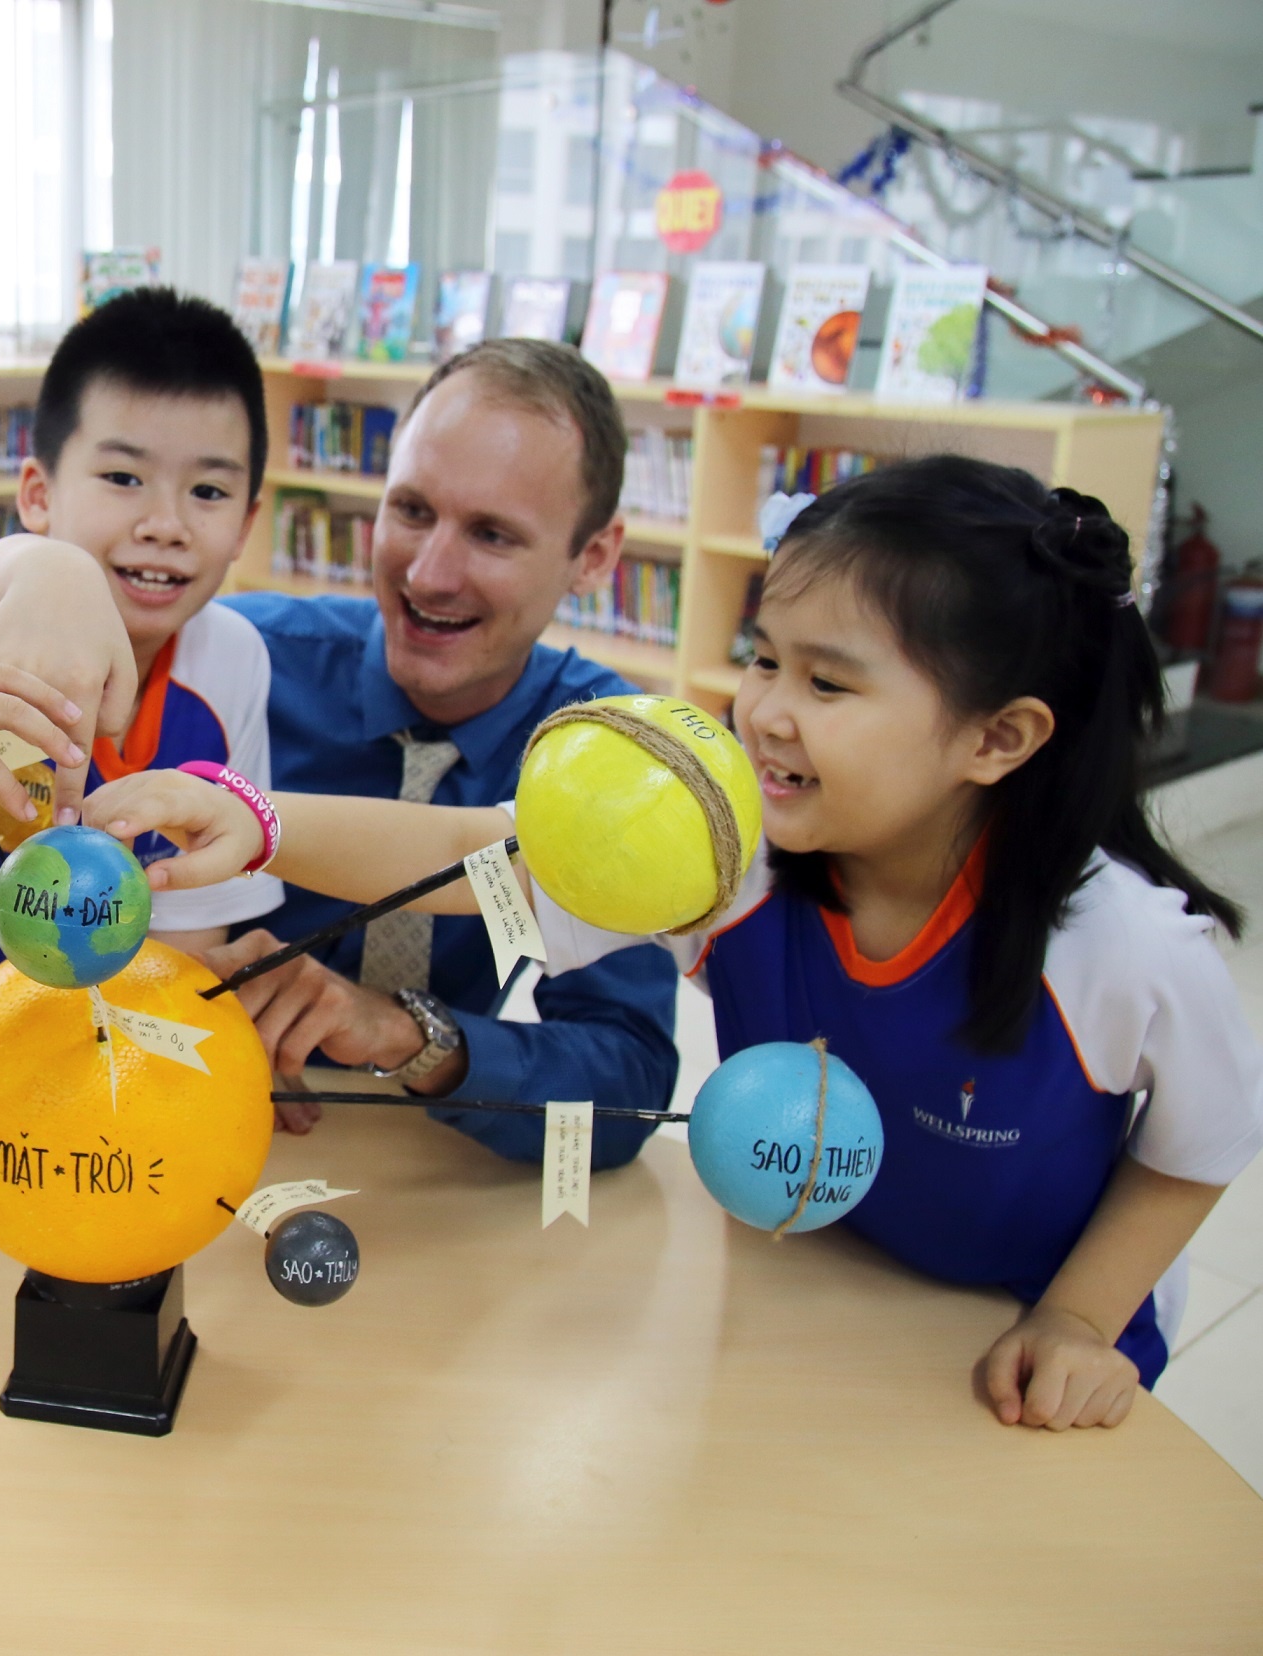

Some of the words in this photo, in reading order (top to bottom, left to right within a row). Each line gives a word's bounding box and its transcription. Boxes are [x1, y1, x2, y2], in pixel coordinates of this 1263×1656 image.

[219, 768, 273, 822] SAIGON
[13, 879, 59, 921] TRÁI
[79, 886, 123, 927] ĐẤT
[69, 1135, 133, 1194] TRỜI
[750, 1139, 802, 1175] SAO
[825, 1136, 876, 1178] THIÊN
[280, 1259, 313, 1284] SAO
